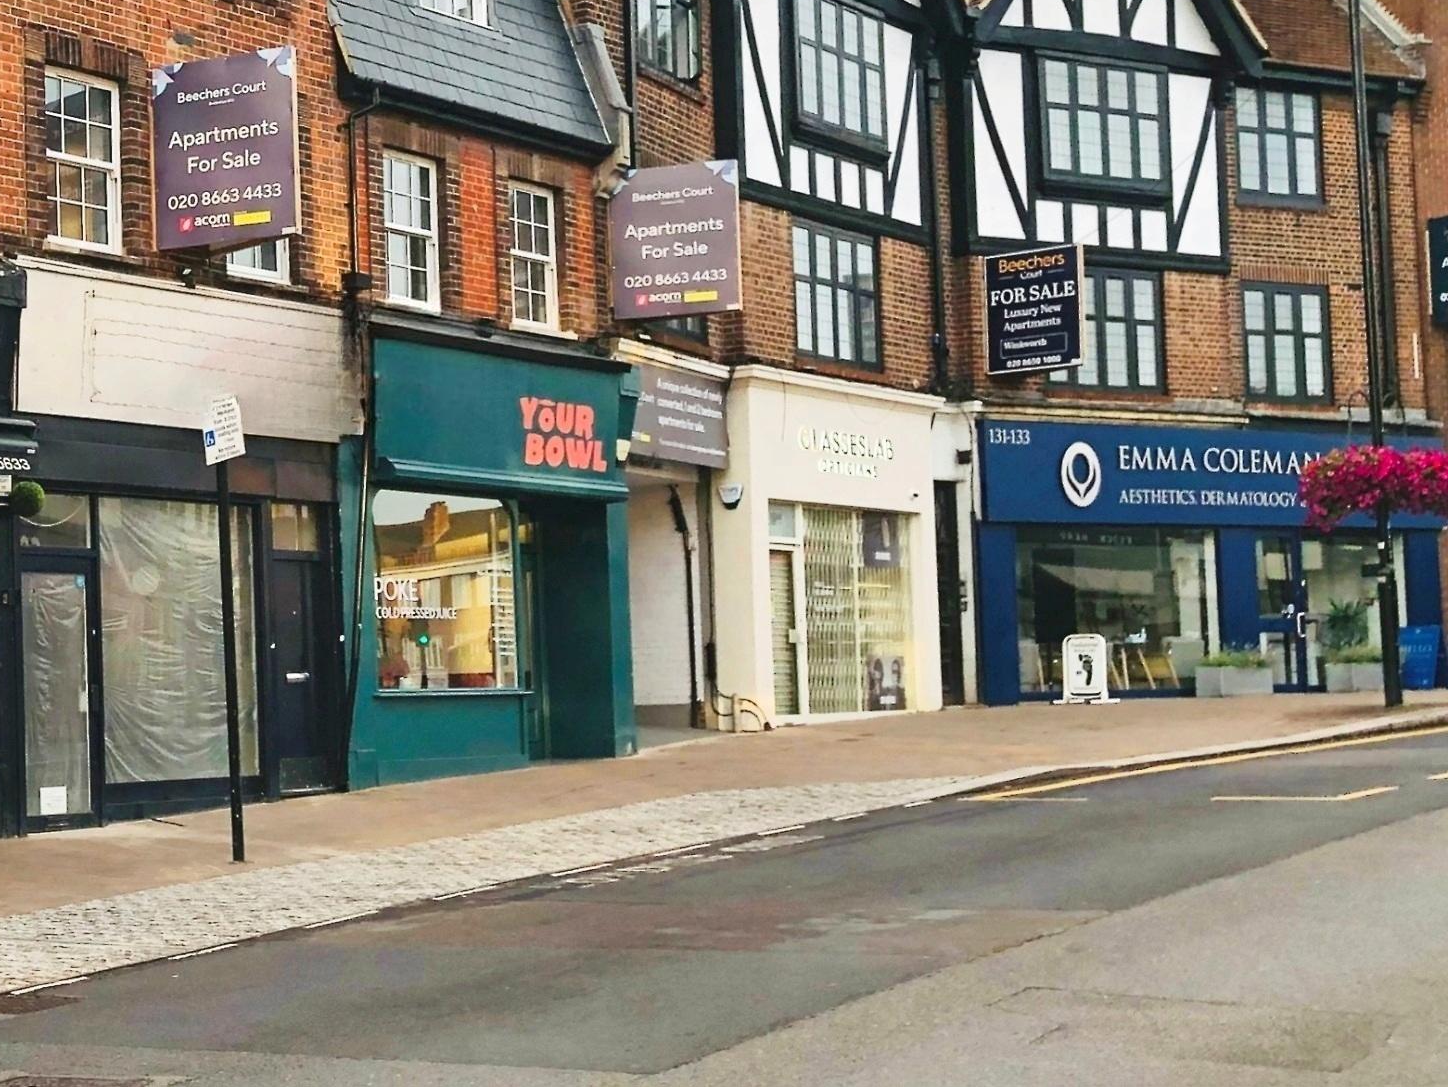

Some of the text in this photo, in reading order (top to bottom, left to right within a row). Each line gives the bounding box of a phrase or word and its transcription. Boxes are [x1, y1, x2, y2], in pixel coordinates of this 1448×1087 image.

[177, 87, 230, 104] Beechers
[232, 80, 267, 95] Court
[168, 119, 279, 151] Apartments
[187, 149, 261, 174] For Sale
[168, 183, 282, 210] 020 8663 4433
[632, 189, 680, 203] Beechers
[682, 186, 714, 198] Court
[194, 213, 231, 226] acorn
[624, 217, 724, 241] Apartments
[641, 241, 708, 260] For Sale
[999, 254, 1065, 273] Beechers
[624, 268, 727, 288] 020 8663 4433
[990, 280, 1075, 306] FOR SALE
[1004, 304, 1062, 319] Luxury New
[1003, 317, 1061, 332] Apartments
[989, 428, 1031, 445] 131-133
[525, 432, 608, 473] BOWL
[1118, 445, 1197, 472] EMMA
[1201, 491, 1298, 507] DERMATOLOGY
[374, 577, 419, 601] POKE
[375, 607, 398, 619] COLD
